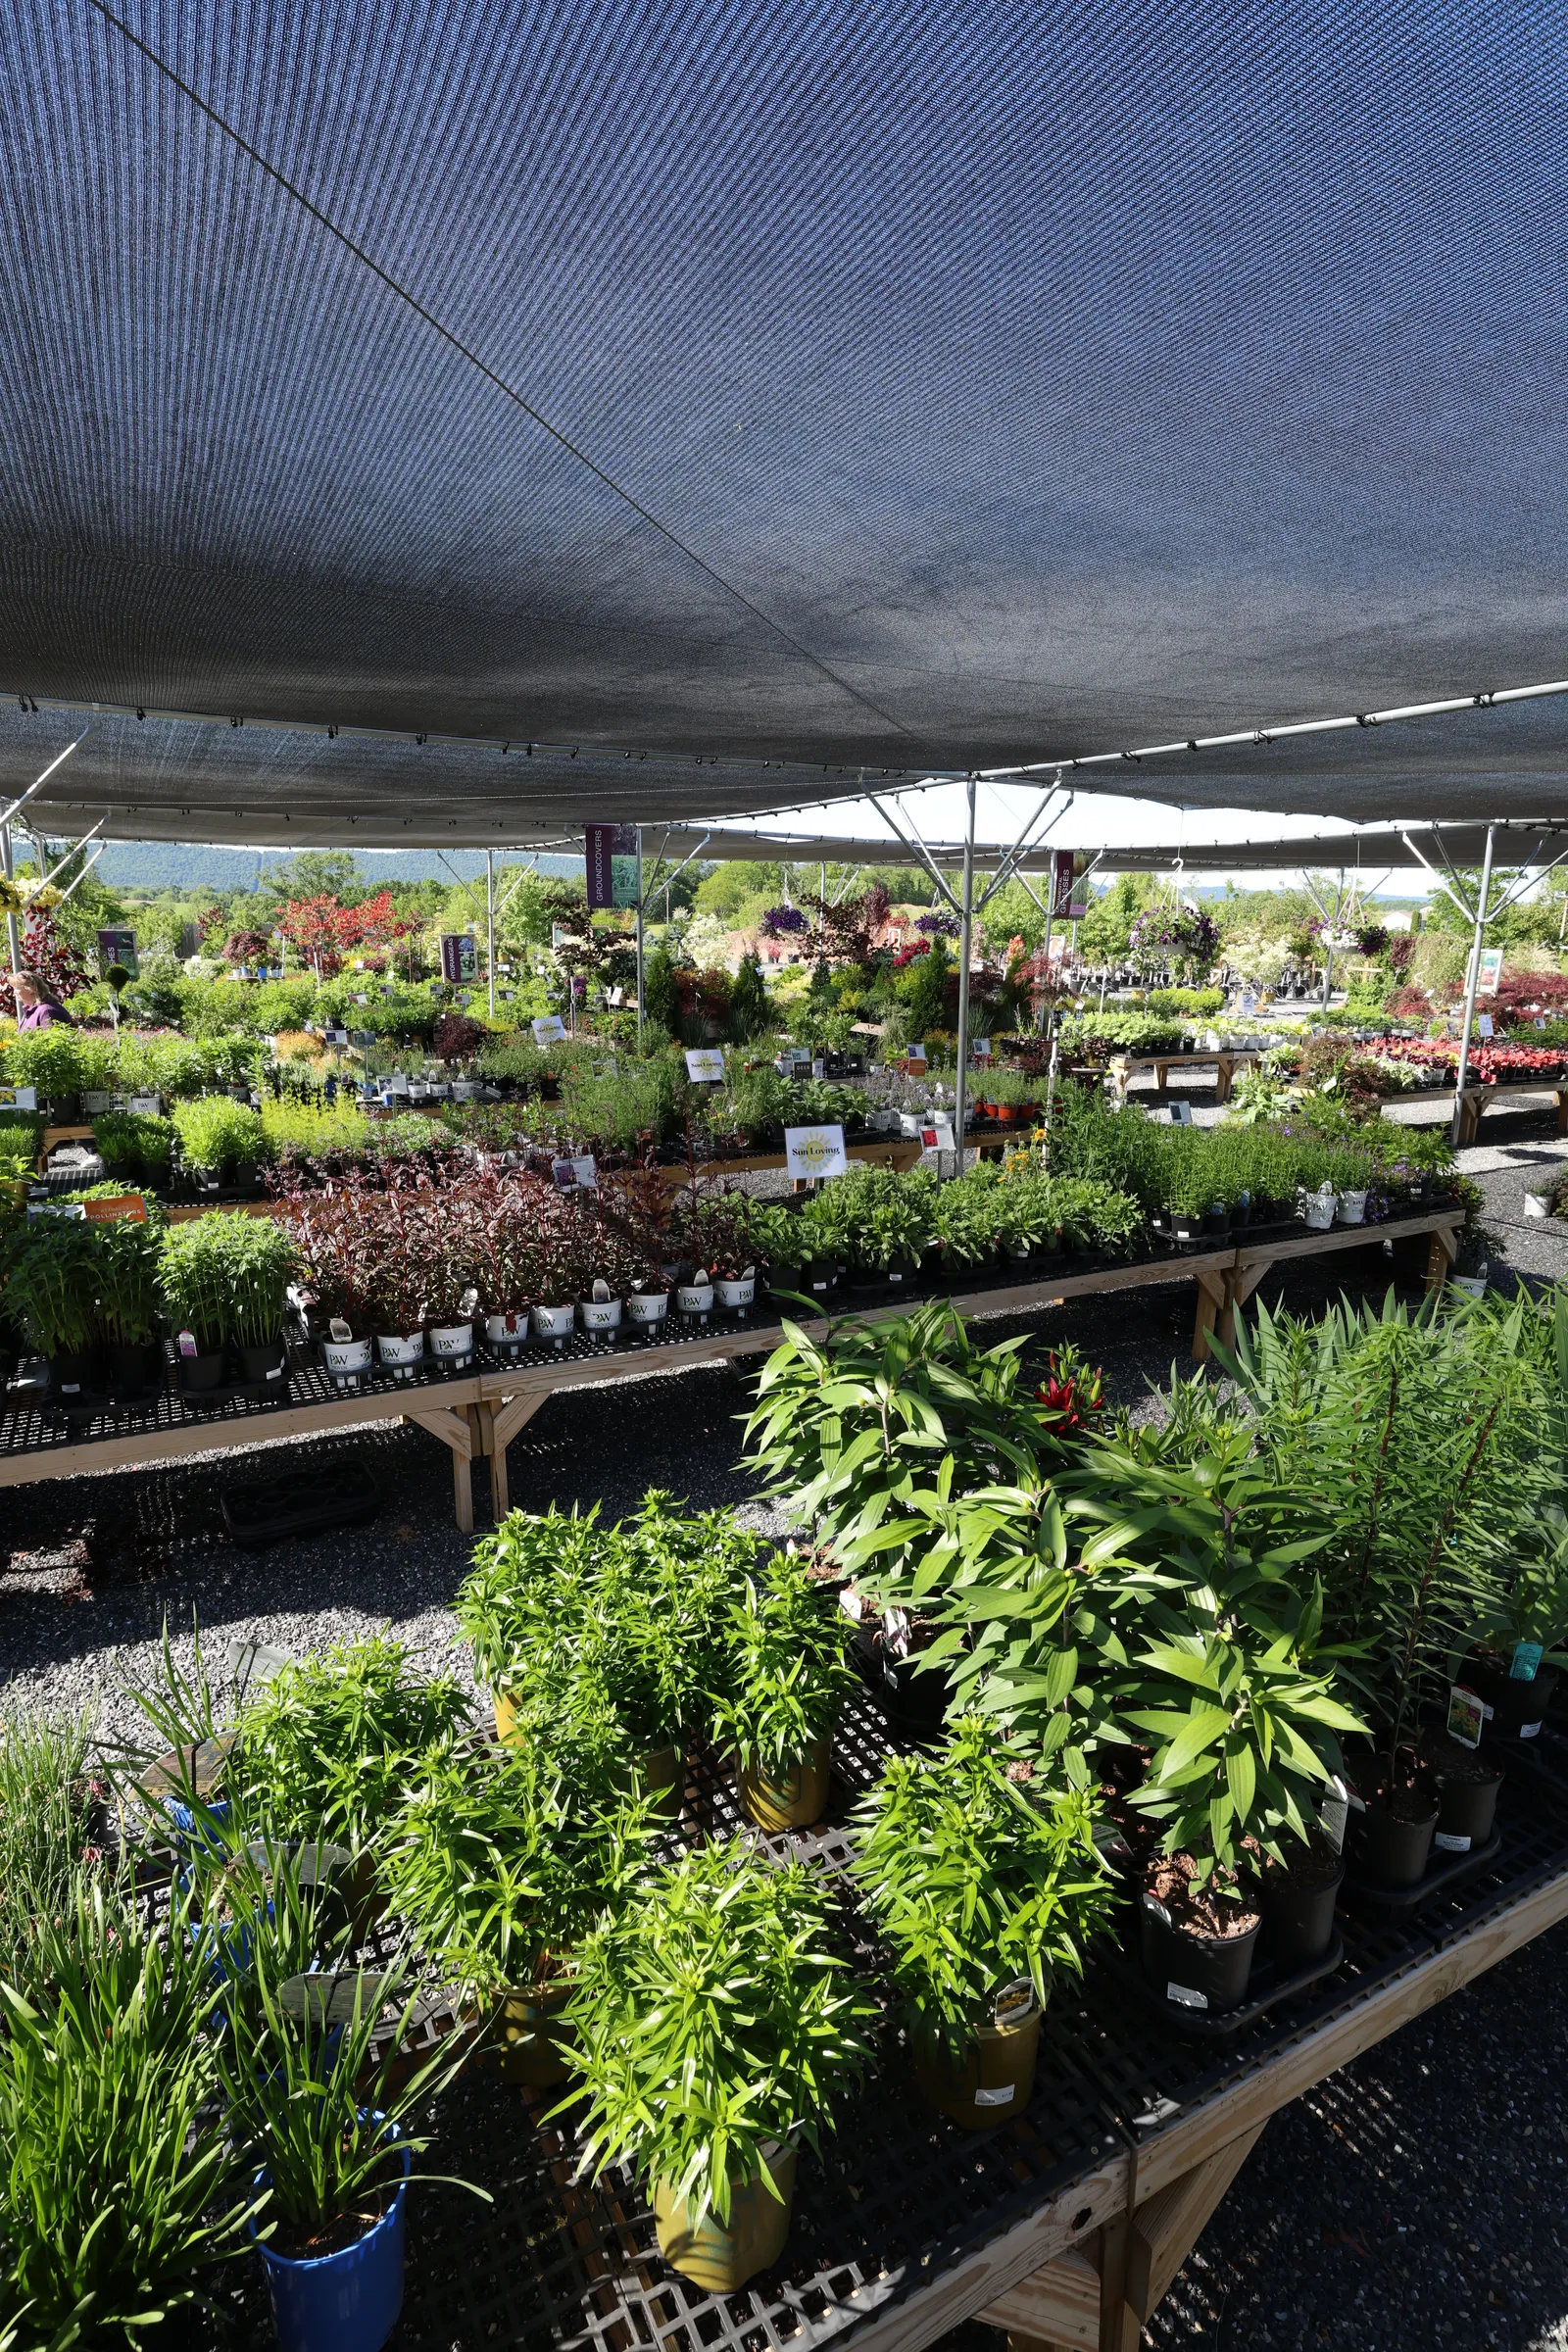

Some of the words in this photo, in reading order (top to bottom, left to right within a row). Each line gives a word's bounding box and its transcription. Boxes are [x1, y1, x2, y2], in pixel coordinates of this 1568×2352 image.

[595, 830, 604, 902] GROUNDCOVERS
[447, 937, 457, 979] HYDRANGEAS
[792, 1148, 808, 1156] Sun
[809, 1146, 841, 1154] Loving
[739, 1289, 753, 1299] PW
[683, 1297, 702, 1306] PW
[630, 1304, 648, 1315] PW
[538, 1318, 556, 1329] PW
[381, 1347, 401, 1358] PW
[329, 1354, 348, 1366] PW
